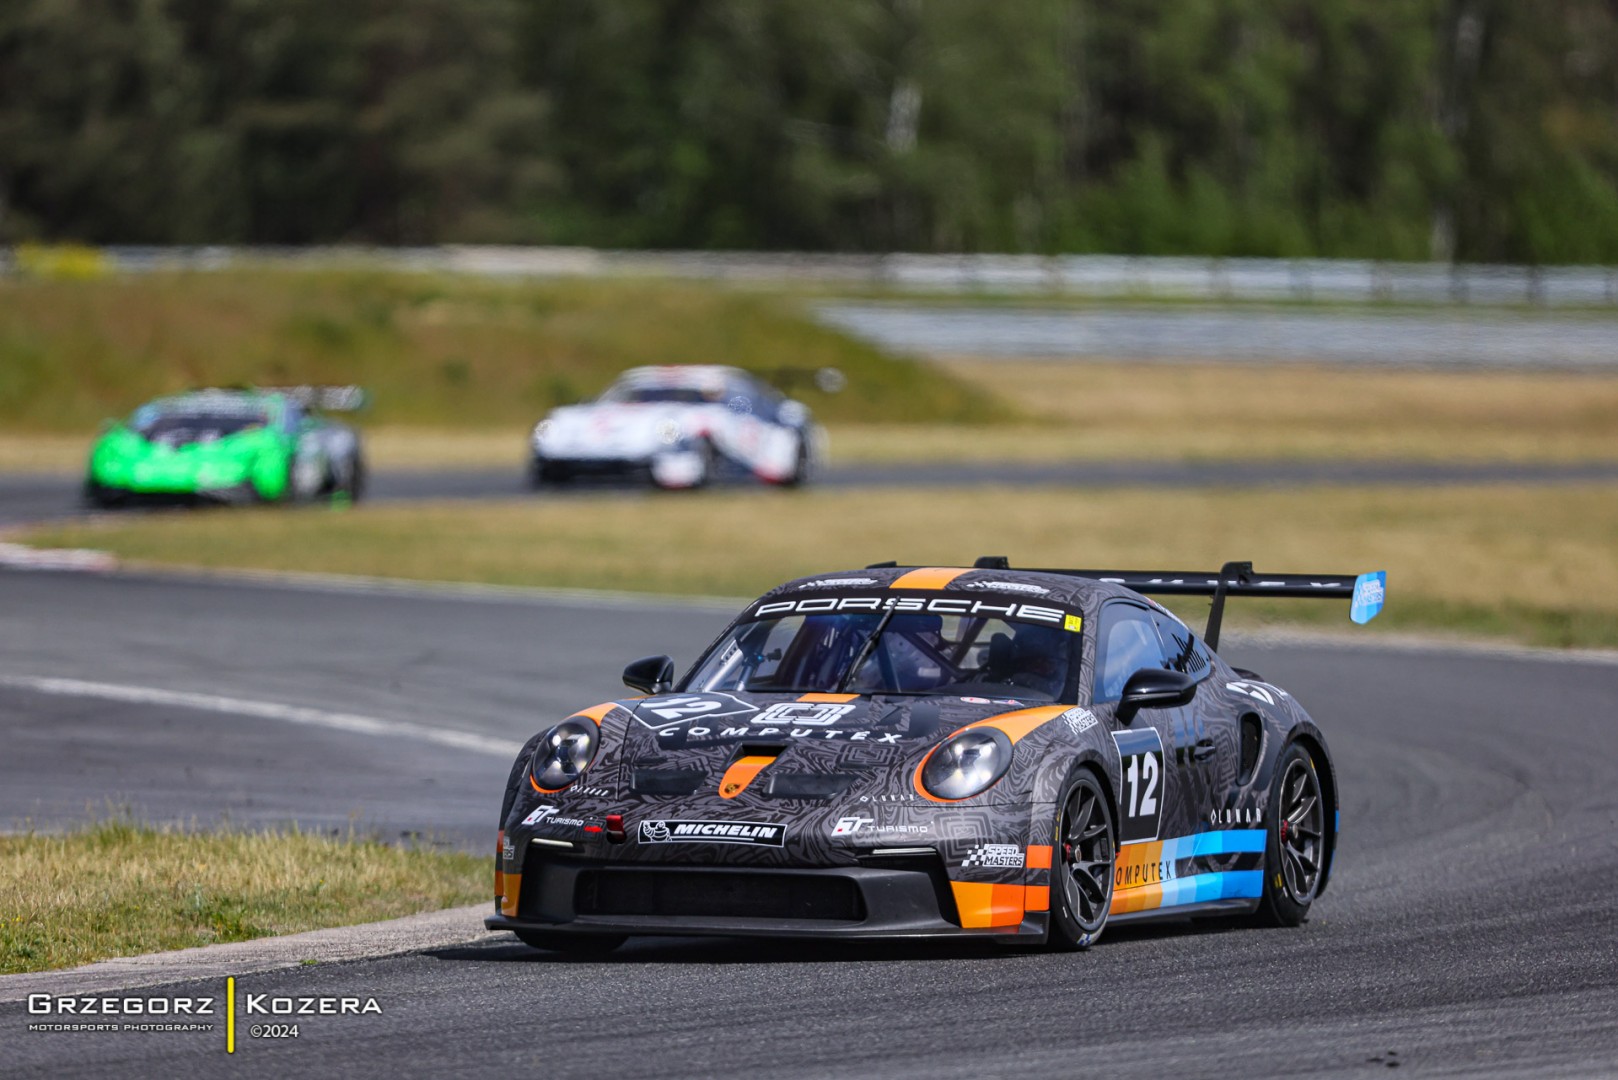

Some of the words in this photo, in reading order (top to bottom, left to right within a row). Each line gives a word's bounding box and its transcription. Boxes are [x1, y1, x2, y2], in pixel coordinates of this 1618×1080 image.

[754, 598, 1065, 622] PORSCHE
[640, 697, 721, 719] 12
[659, 726, 902, 744] COMPUTEX
[1127, 751, 1159, 818] 12
[546, 816, 584, 826] TURISMO
[867, 825, 928, 833] TURISMO
[674, 824, 777, 838] MICHELIN
[988, 846, 1018, 856] SPEED
[983, 856, 1023, 866] MASTERS
[1115, 860, 1172, 886] OMPUTEX
